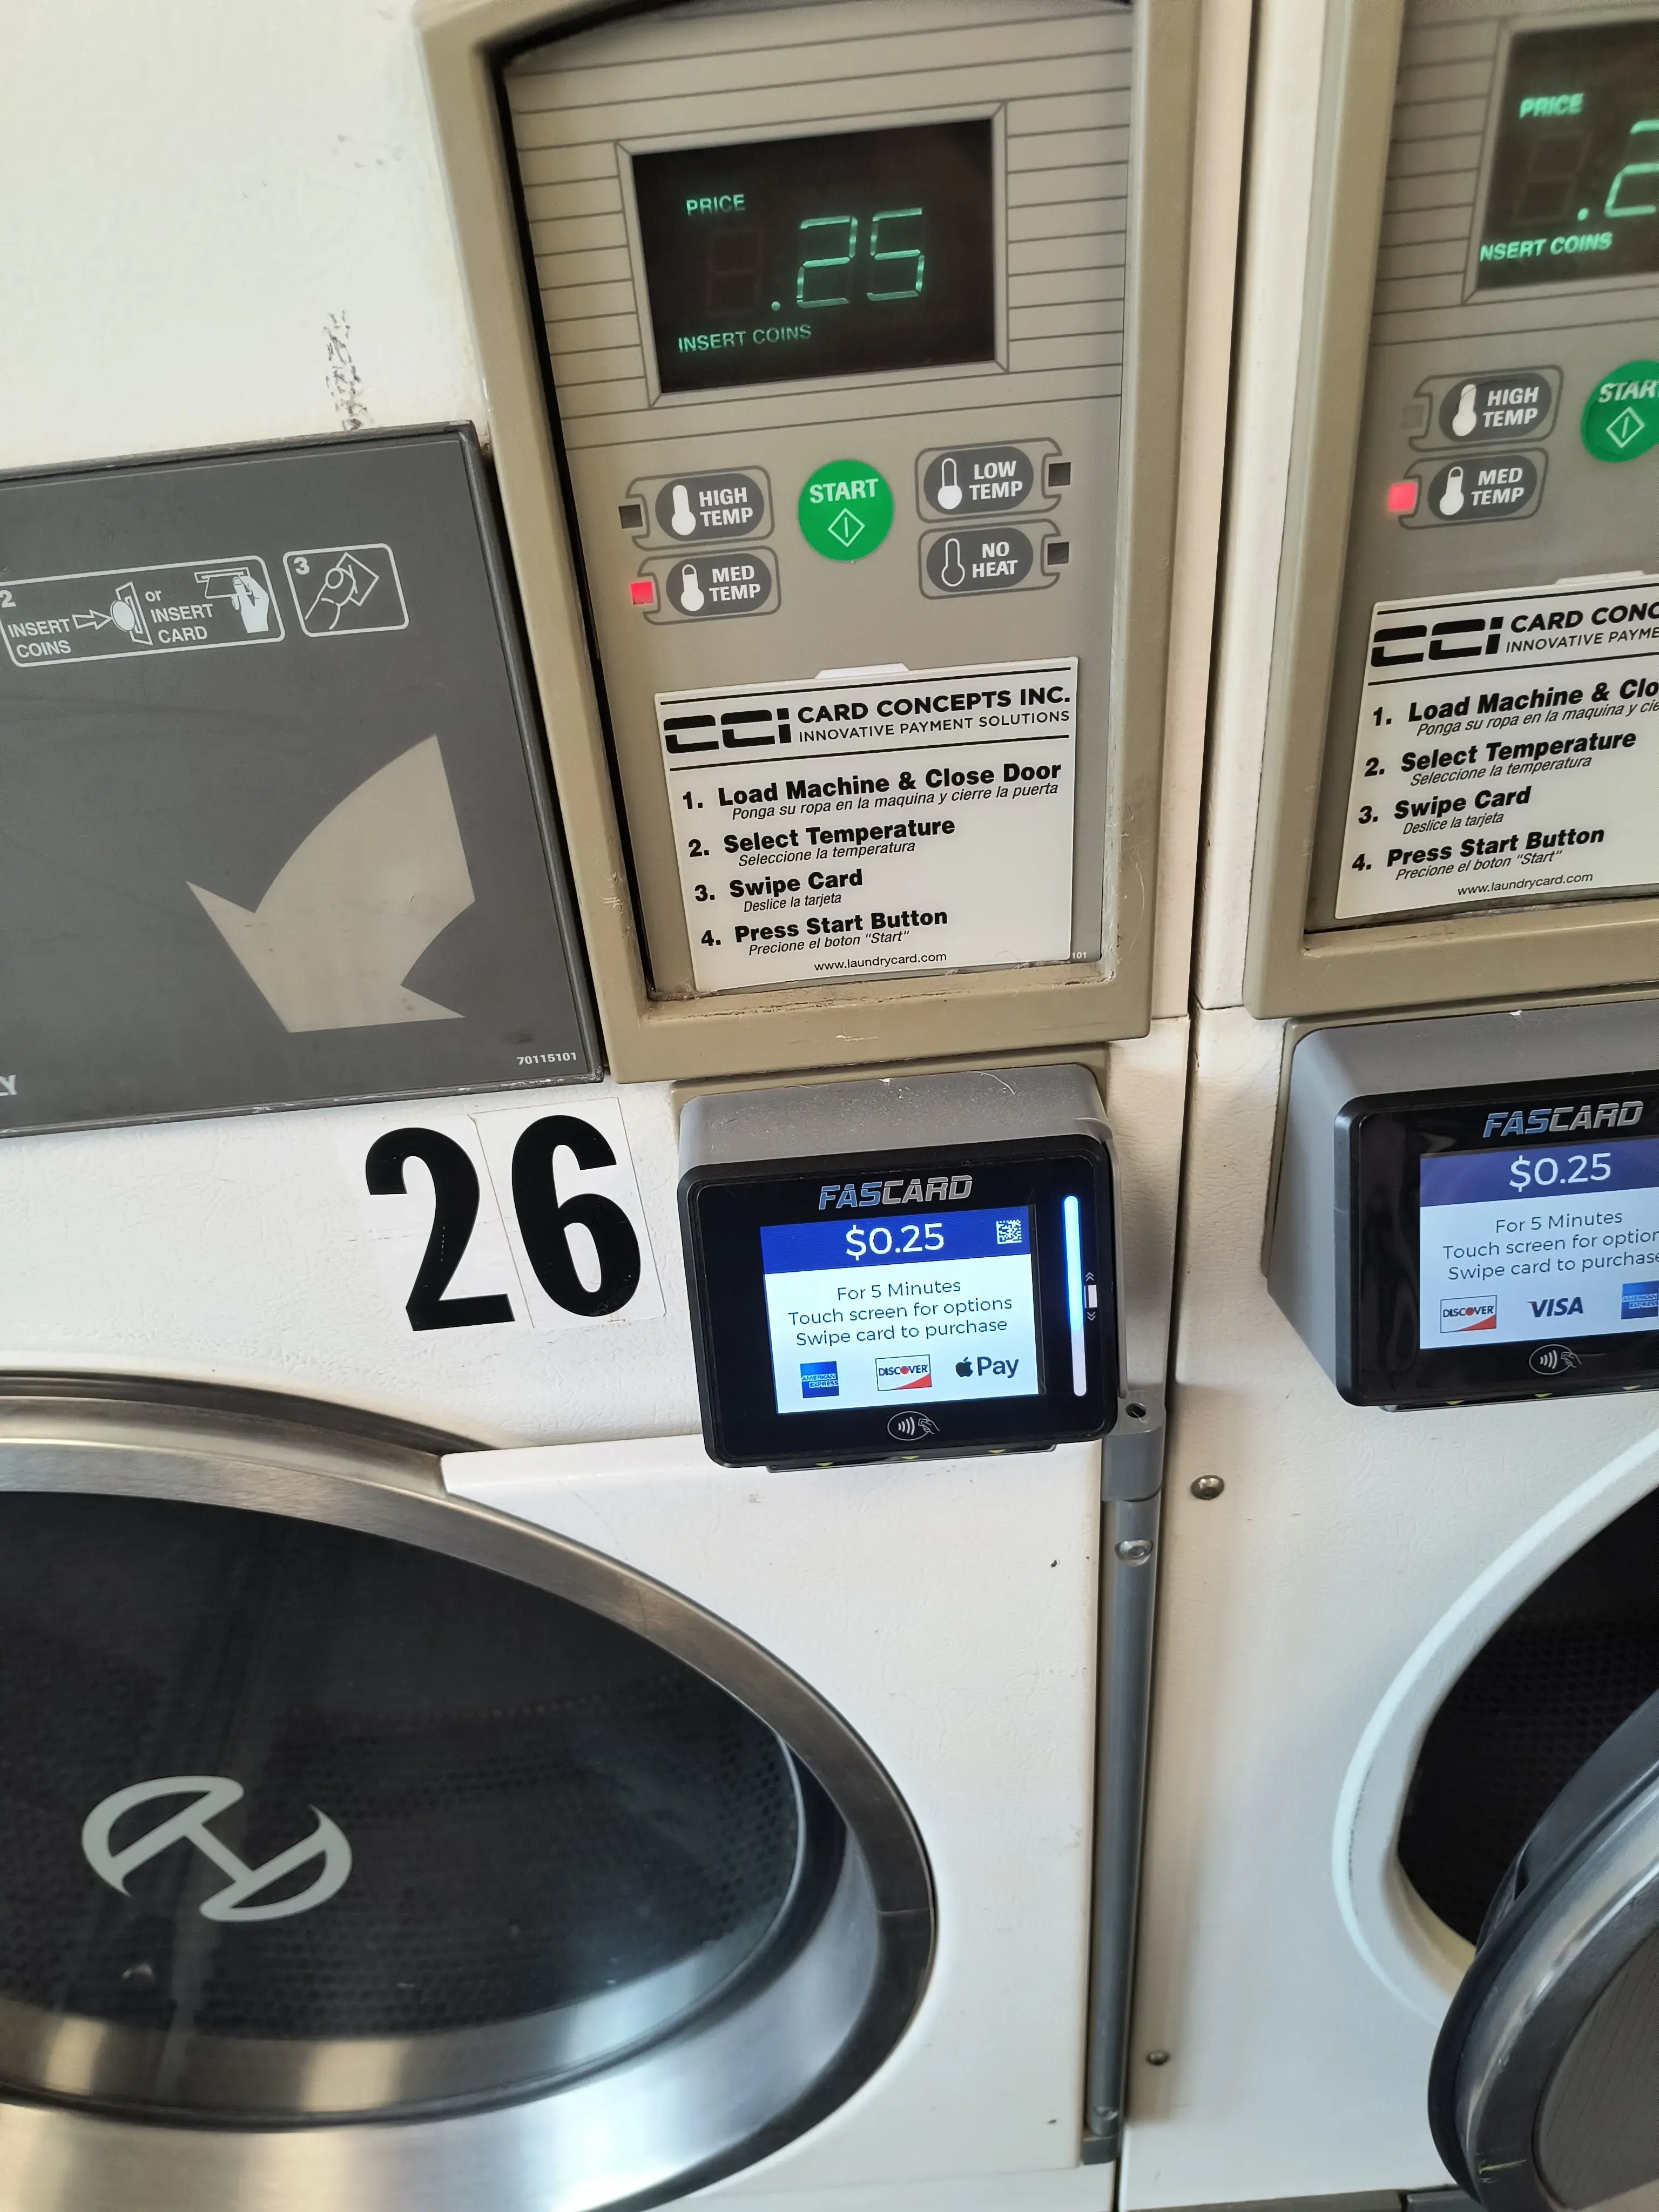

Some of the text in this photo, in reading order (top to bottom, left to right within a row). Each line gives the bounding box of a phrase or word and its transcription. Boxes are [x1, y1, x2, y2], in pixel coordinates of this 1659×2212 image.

[1519, 92, 1584, 119] PRICE
[686, 193, 745, 216] PRICE
[1480, 232, 1614, 262] NSERT COINS
[771, 208, 925, 312] .25
[678, 324, 811, 353] INSERT COINS
[1487, 387, 1539, 407] HIGH
[1599, 379, 1659, 403] STAR
[1482, 408, 1538, 428] TEMP
[974, 461, 1017, 480] LOW
[1478, 467, 1523, 487] MED
[699, 487, 748, 507] HIGH
[809, 478, 879, 504] START
[969, 481, 1023, 501] TEMP
[1471, 487, 1524, 506] TEMP
[700, 507, 753, 527] TEMP
[982, 541, 1009, 559] NO
[294, 557, 311, 575] 3
[712, 565, 755, 583] MED
[972, 559, 1018, 578] HEAT
[0, 590, 16, 608] 2
[145, 590, 162, 602] or
[709, 583, 761, 602] TEMP
[150, 603, 213, 623] INSERT
[1510, 610, 1583, 633] CARD
[8, 619, 70, 638] INSERT
[158, 626, 208, 644] CARD
[17, 640, 71, 658] COINS
[1506, 632, 1604, 653] INNOVATIVE
[798, 686, 1070, 724] CARD CONCEPTS INC.
[1373, 707, 1392, 726] 1.
[1408, 696, 1469, 723] Load
[1476, 687, 1583, 714] Machine
[1591, 682, 1610, 703] &
[799, 710, 1070, 743] INNOVATIVE PAYMENT SOLUTIONS
[1417, 720, 1460, 737] Ponga
[1465, 720, 1482, 731] su
[1486, 716, 1519, 731] ropa
[1523, 712, 1541, 724] en
[1545, 709, 1558, 722] la
[1561, 704, 1625, 721] maquina
[1624, 704, 1638, 717] y
[1364, 732, 1637, 777] 2. Select Temperature
[1410, 756, 1592, 787] Seleccione la temperatura
[683, 762, 1062, 811] 1. Load Machine & Close Door
[732, 783, 1058, 821] Ponga su ropa en la maquina y cierre la puerta
[1358, 786, 1532, 824] 3. Swipe Card
[1403, 812, 1504, 835] Deslice la tarjeta
[689, 818, 956, 858] 2. Select Temperature
[1352, 827, 1605, 872] 4. Press Start Button
[739, 840, 916, 867] Seleccione la temperatura
[1396, 850, 1563, 881] Precione el boton "Start"
[695, 869, 864, 902] 3. Swipe Card
[1458, 873, 1593, 896] www.laundrycard.com
[744, 892, 842, 913] Deslice la tarjeta
[701, 909, 948, 947] 4. Press Start Button
[748, 930, 909, 956] Precione el boton "Start"
[814, 952, 947, 972] www.laundrycard.com
[517, 1052, 577, 1065] 70115101
[1482, 1100, 1643, 1138] FASCARD
[1509, 1152, 1611, 1192] $0.25
[819, 1175, 972, 1210] FASCARD
[365, 1114, 642, 1331] 26
[1496, 1212, 1622, 1234] For 5 Minutes
[846, 1223, 945, 1260] $0.25
[1442, 1242, 1500, 1259] Touch
[1506, 1238, 1566, 1255] screen
[1572, 1233, 1597, 1249] for
[1448, 1265, 1505, 1282] Swipe
[1511, 1258, 1550, 1275] card
[1557, 1258, 1575, 1272] to
[838, 1279, 961, 1301] For 5 Minutes
[788, 1295, 1012, 1325] Touch screen for options
[1442, 1305, 1494, 1318] DISCOVER
[1527, 1297, 1584, 1318] VISA
[796, 1318, 1007, 1346] Swipe card to purchase
[879, 1364, 928, 1376] DISCOVER
[977, 1356, 1019, 1379] Pay
